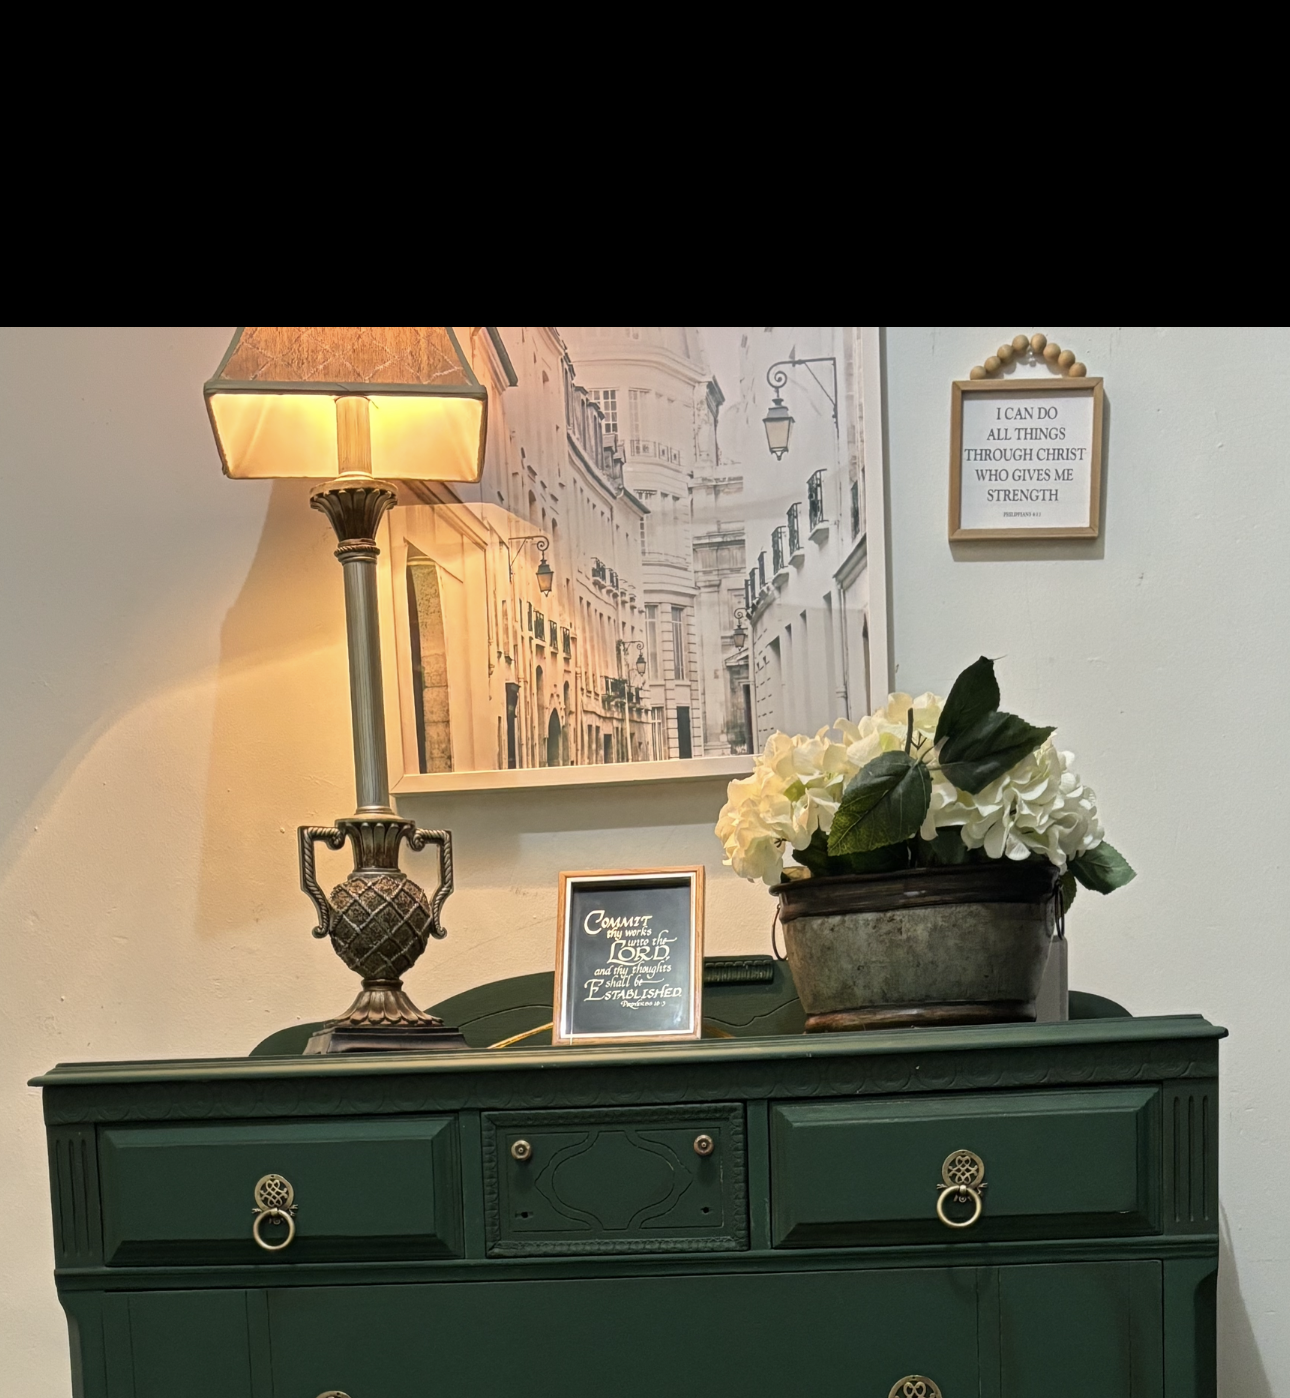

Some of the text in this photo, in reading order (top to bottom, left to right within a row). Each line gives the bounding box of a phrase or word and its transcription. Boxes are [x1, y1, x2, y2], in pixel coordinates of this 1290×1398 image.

[996, 406, 1058, 420] I CAN DO
[986, 427, 1066, 441] ALL THINGS
[964, 447, 1087, 461] THROUGH CHRIST
[975, 468, 1074, 482] WHO GIVES ME
[986, 488, 1059, 502] STRENGTH
[606, 926, 652, 941] thy works
[627, 930, 678, 947] unto the
[606, 939, 671, 966] LORD,
[594, 960, 672, 979] and thy thoughts
[605, 974, 634, 988] shall
